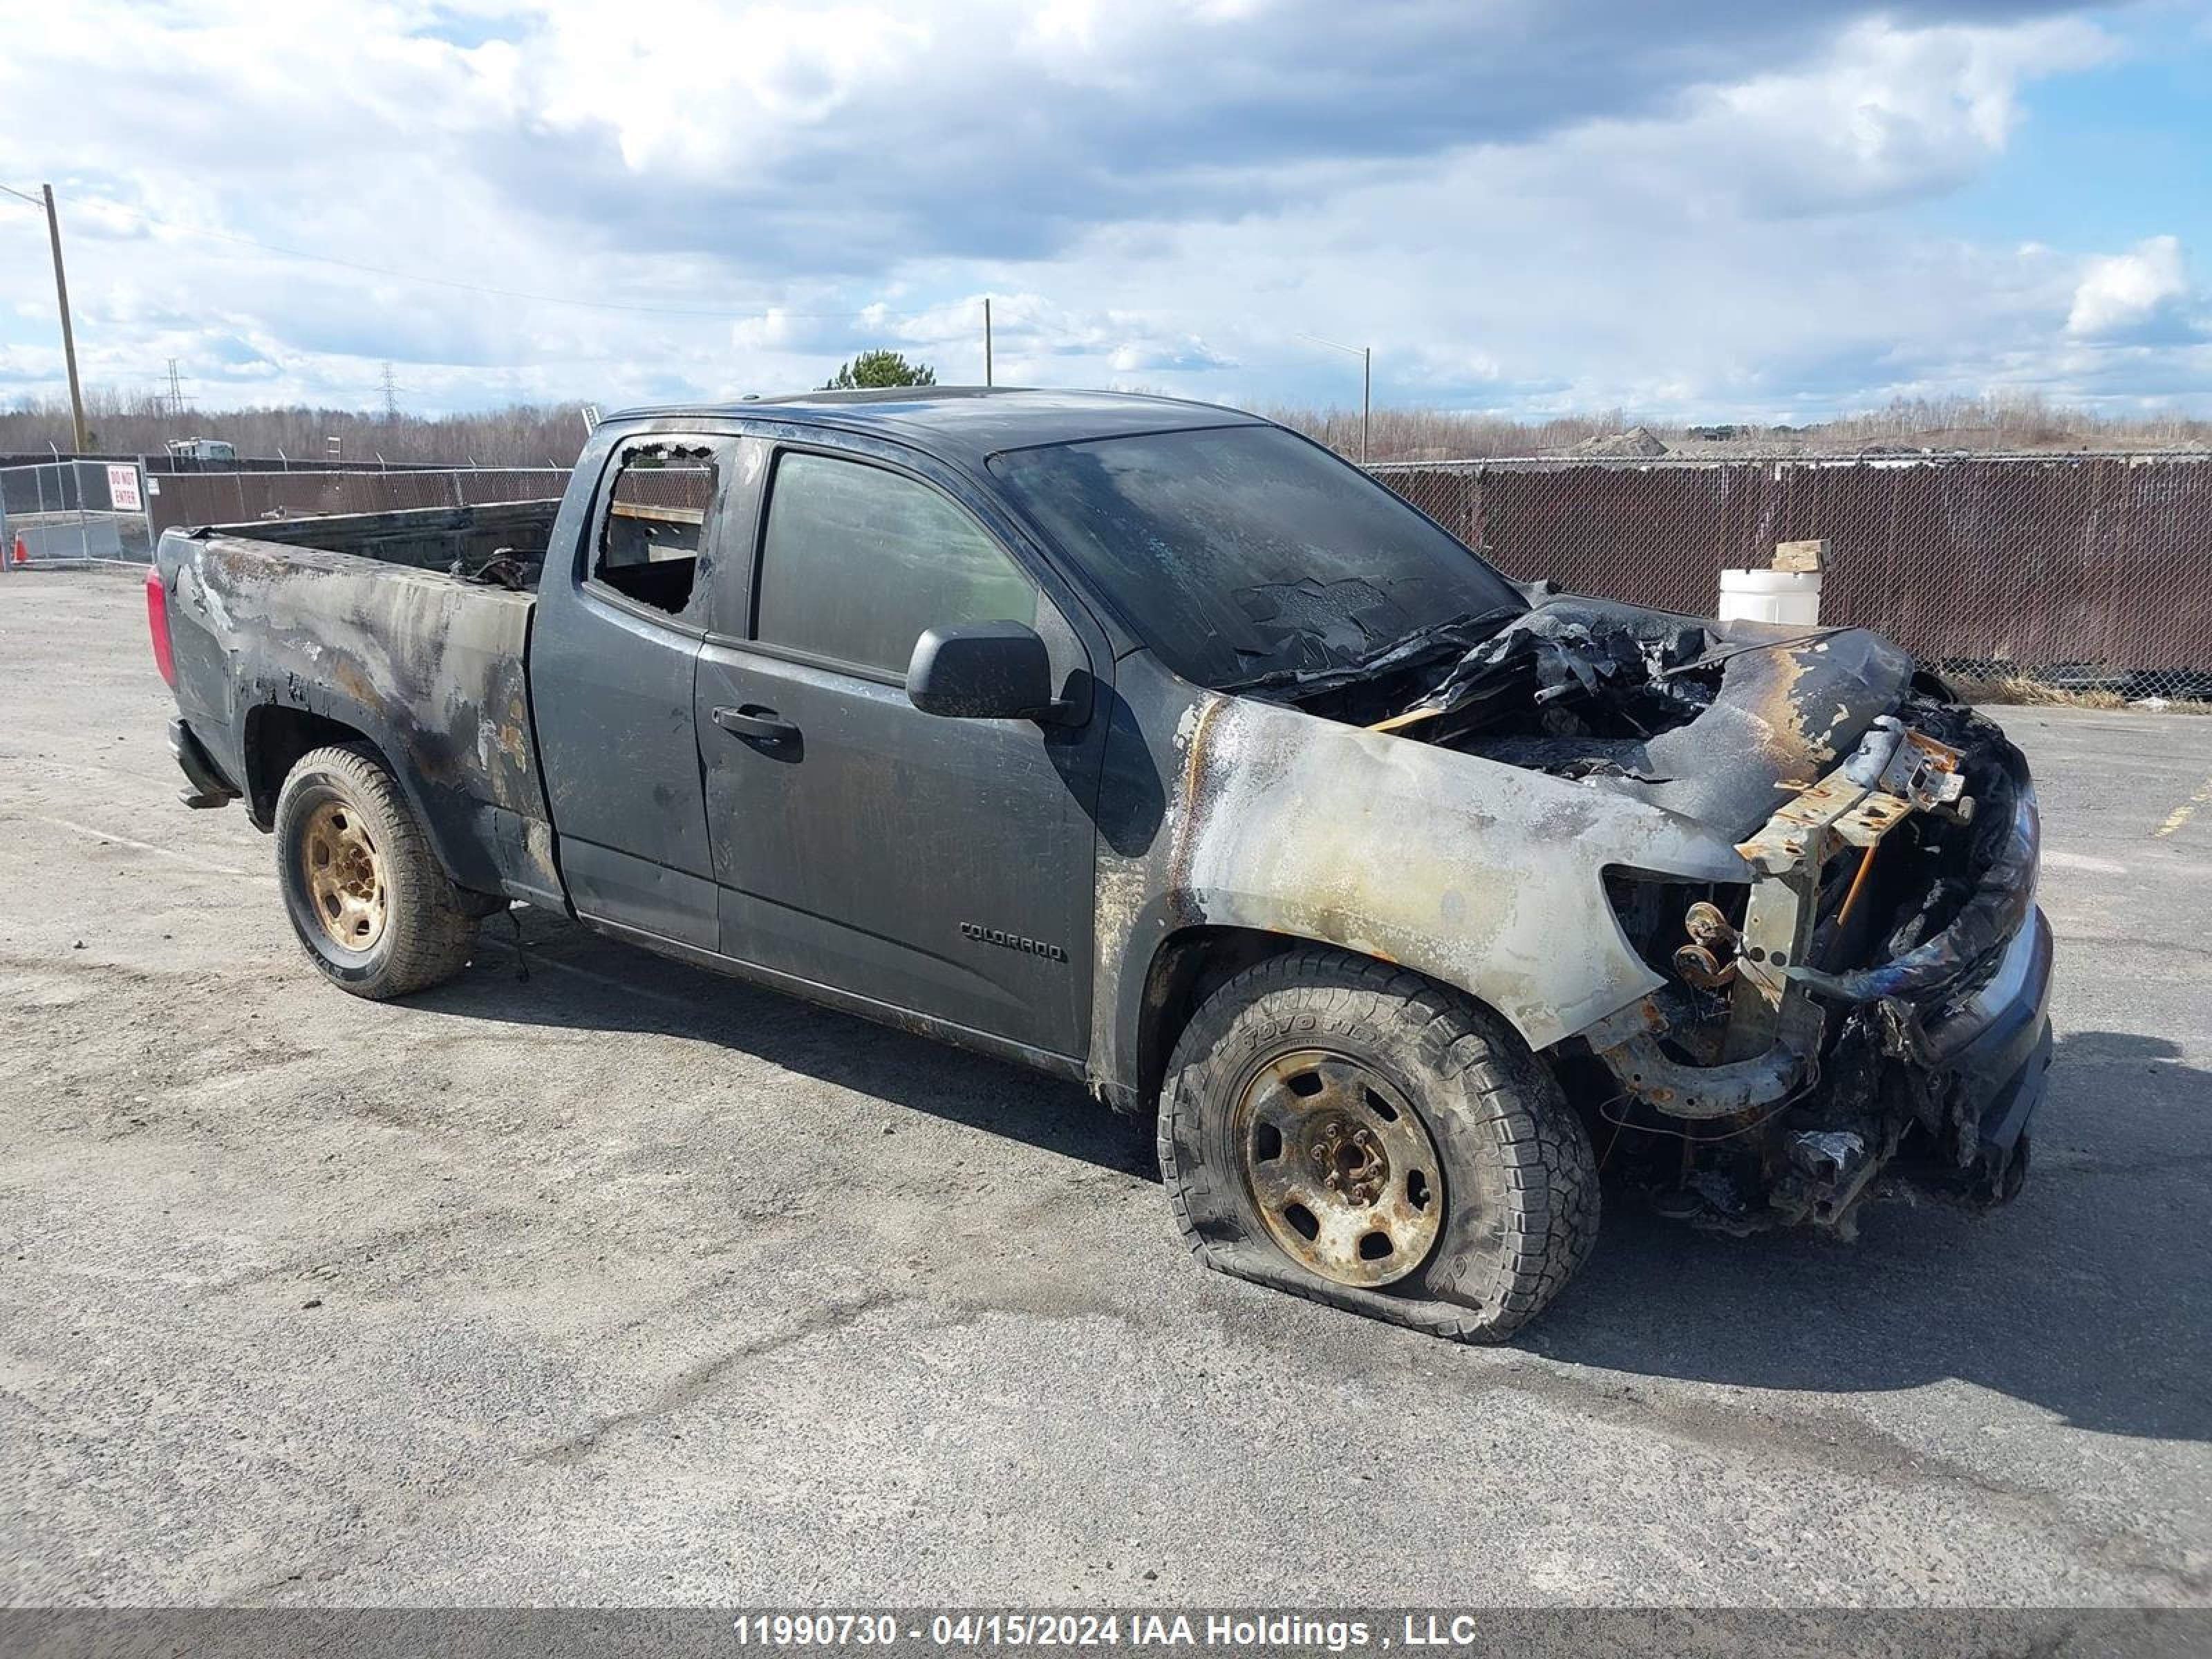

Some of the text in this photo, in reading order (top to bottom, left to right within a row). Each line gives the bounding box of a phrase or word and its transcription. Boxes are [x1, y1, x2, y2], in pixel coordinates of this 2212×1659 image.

[111, 471, 135, 486] DO NOT
[115, 489, 137, 505] ENTER
[959, 921, 1065, 960] COLORADO
[1241, 1013, 1317, 1051] TOYO
